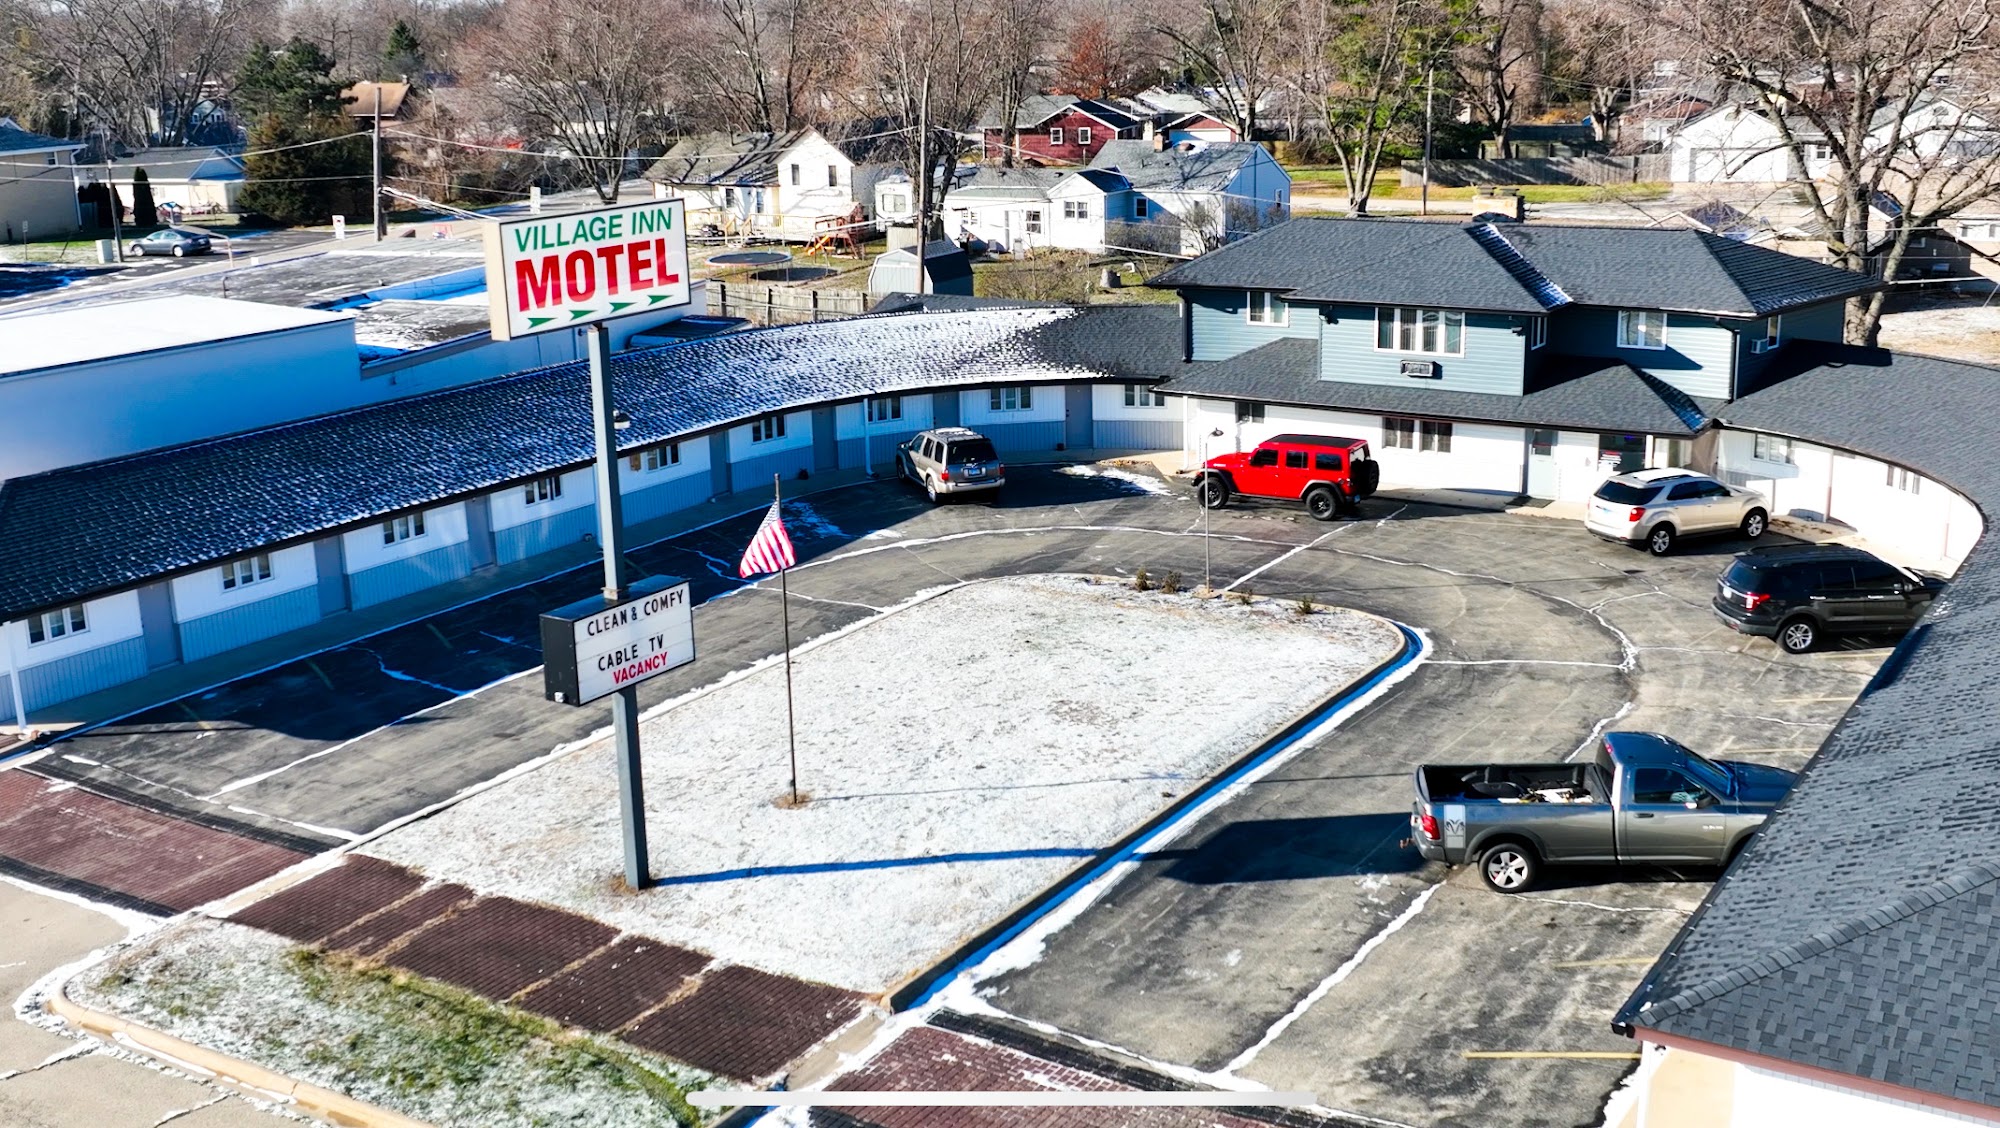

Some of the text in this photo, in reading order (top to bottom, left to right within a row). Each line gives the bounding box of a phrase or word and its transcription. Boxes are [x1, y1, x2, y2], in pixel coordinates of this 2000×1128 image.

[514, 207, 672, 252] VILLAGE INN
[515, 238, 680, 313] MOTEL
[587, 589, 684, 636] CLEAN & COMFY
[598, 634, 664, 671] CABLE TV
[613, 652, 668, 684] VACANCY
